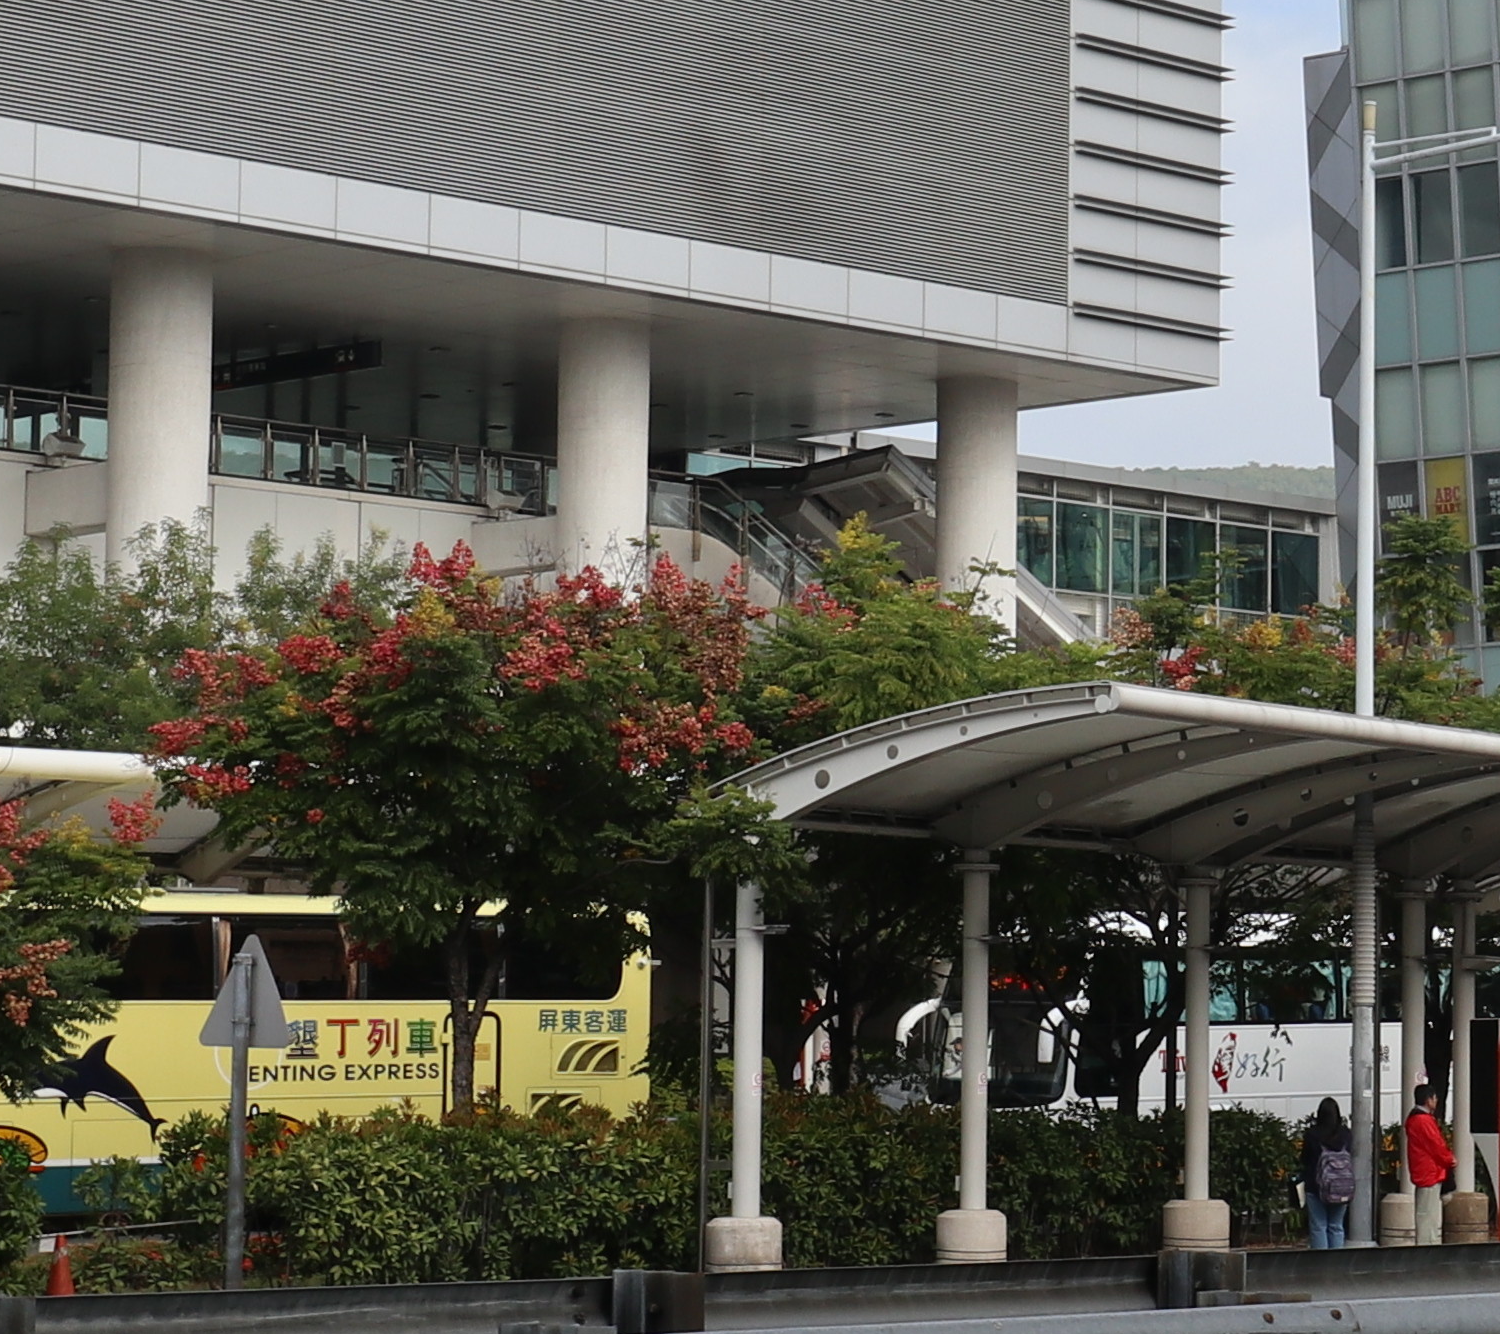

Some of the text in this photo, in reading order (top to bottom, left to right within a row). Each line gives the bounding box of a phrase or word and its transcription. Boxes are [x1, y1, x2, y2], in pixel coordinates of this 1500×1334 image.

[1386, 494, 1413, 510] MUJI
[1435, 486, 1461, 503] ABC
[1435, 503, 1462, 515] MART
[538, 1008, 628, 1034] 屏東客運
[285, 1017, 439, 1059] 墾丁列車
[249, 1062, 440, 1084] ENTING EXPRESS
